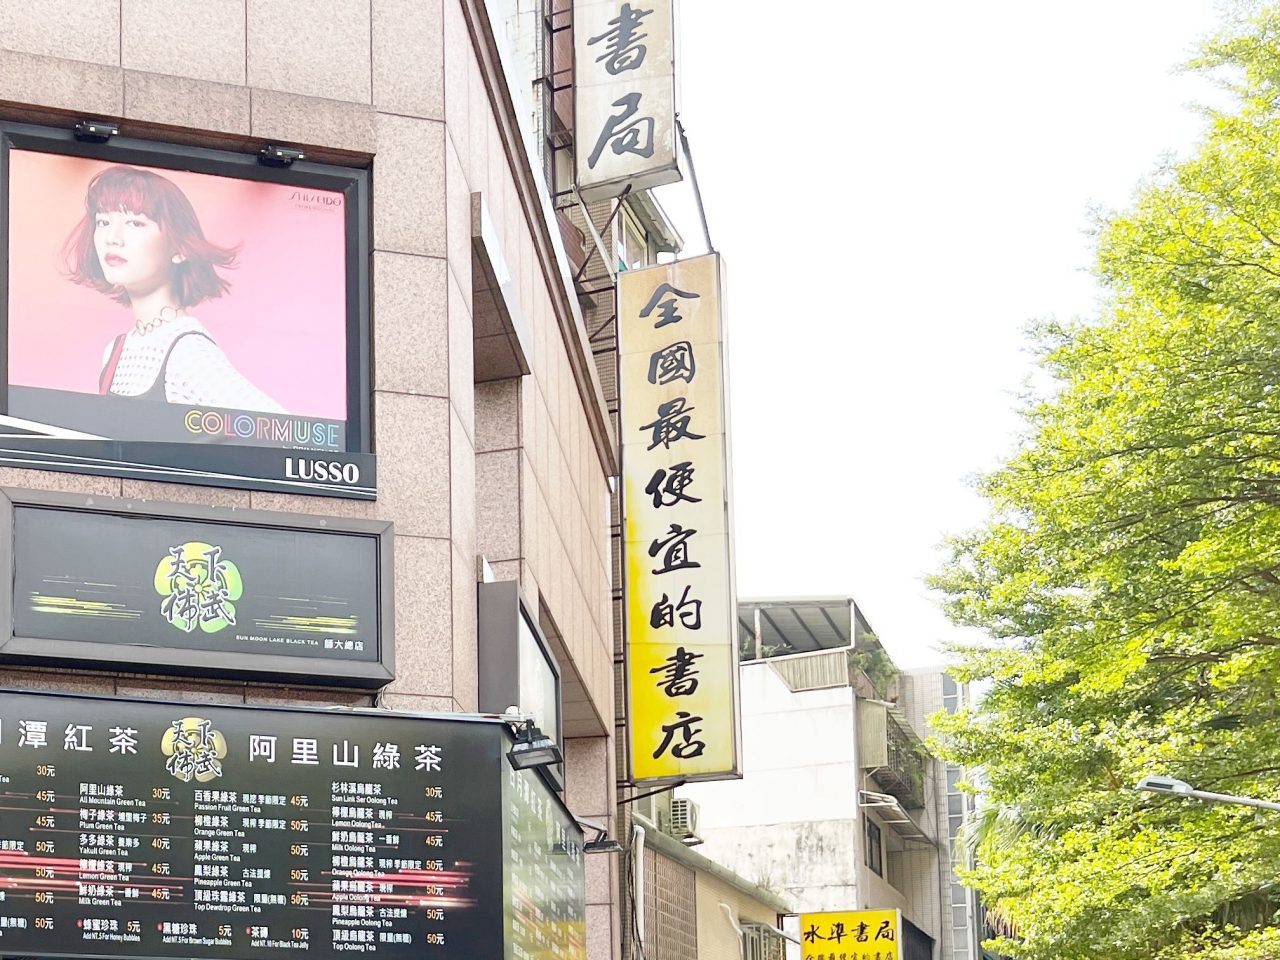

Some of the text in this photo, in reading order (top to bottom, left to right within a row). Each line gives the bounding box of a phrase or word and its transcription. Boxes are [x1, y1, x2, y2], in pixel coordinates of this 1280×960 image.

[587, 2, 655, 170] 書局
[184, 409, 340, 448] COLORMUSE
[285, 457, 360, 484] LUSSO
[639, 282, 707, 760] 全國最便宜的書店
[248, 734, 443, 772] 阿里山綠茶
[36, 765, 56, 777] 30元
[36, 790, 55, 802] 45元
[80, 783, 171, 800] 阿里山綠茶 30元
[425, 786, 443, 798] 30元
[290, 795, 309, 807] 45元
[331, 794, 343, 802] Sun
[343, 795, 356, 803] Link
[366, 796, 387, 806] Oolong
[387, 797, 398, 805] Tea
[194, 802, 261, 813] Passion Fruit Green Tea
[36, 815, 55, 828] 45元
[152, 813, 171, 825] 35元
[425, 811, 443, 823] 45元
[290, 820, 309, 832] 50元
[36, 841, 55, 853] 50元
[151, 838, 170, 850] 40元
[151, 863, 170, 875] 45元
[426, 860, 444, 871] 50元
[290, 869, 309, 881] 50元
[35, 892, 54, 904] 50元
[426, 909, 444, 920] 50元
[35, 918, 54, 930] 50元
[127, 920, 141, 933] 5元
[218, 925, 232, 937] 5元
[291, 928, 309, 940] 10元
[803, 920, 895, 944] 水準書局
[426, 933, 445, 945] 50元
